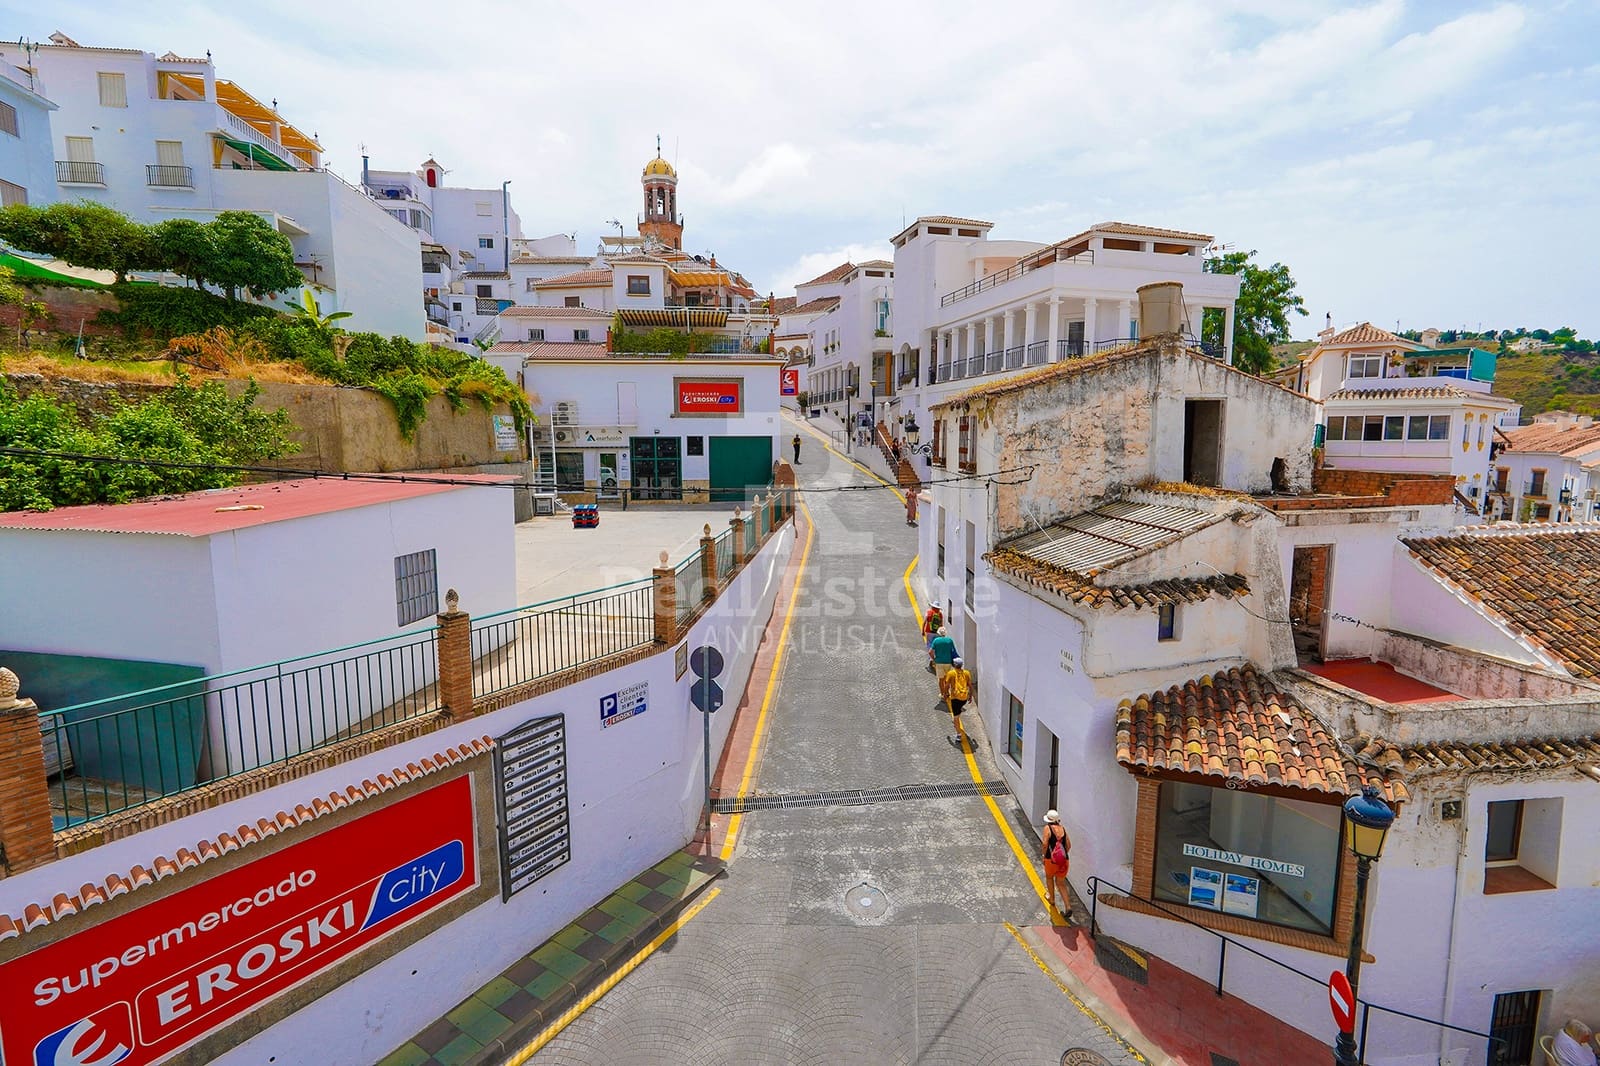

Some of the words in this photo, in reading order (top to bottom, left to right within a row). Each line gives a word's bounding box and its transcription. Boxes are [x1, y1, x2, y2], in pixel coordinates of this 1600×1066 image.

[618, 681, 648, 698] Exclusivo
[620, 690, 646, 704] clientes
[603, 697, 615, 717] P
[518, 750, 550, 768] Ayuntamiento
[1185, 845, 1244, 863] HOLIDAY
[1250, 857, 1304, 876] HOMES
[34, 869, 317, 1006] Supermercado
[156, 899, 355, 1026] EROSKI
[389, 860, 446, 903] city
